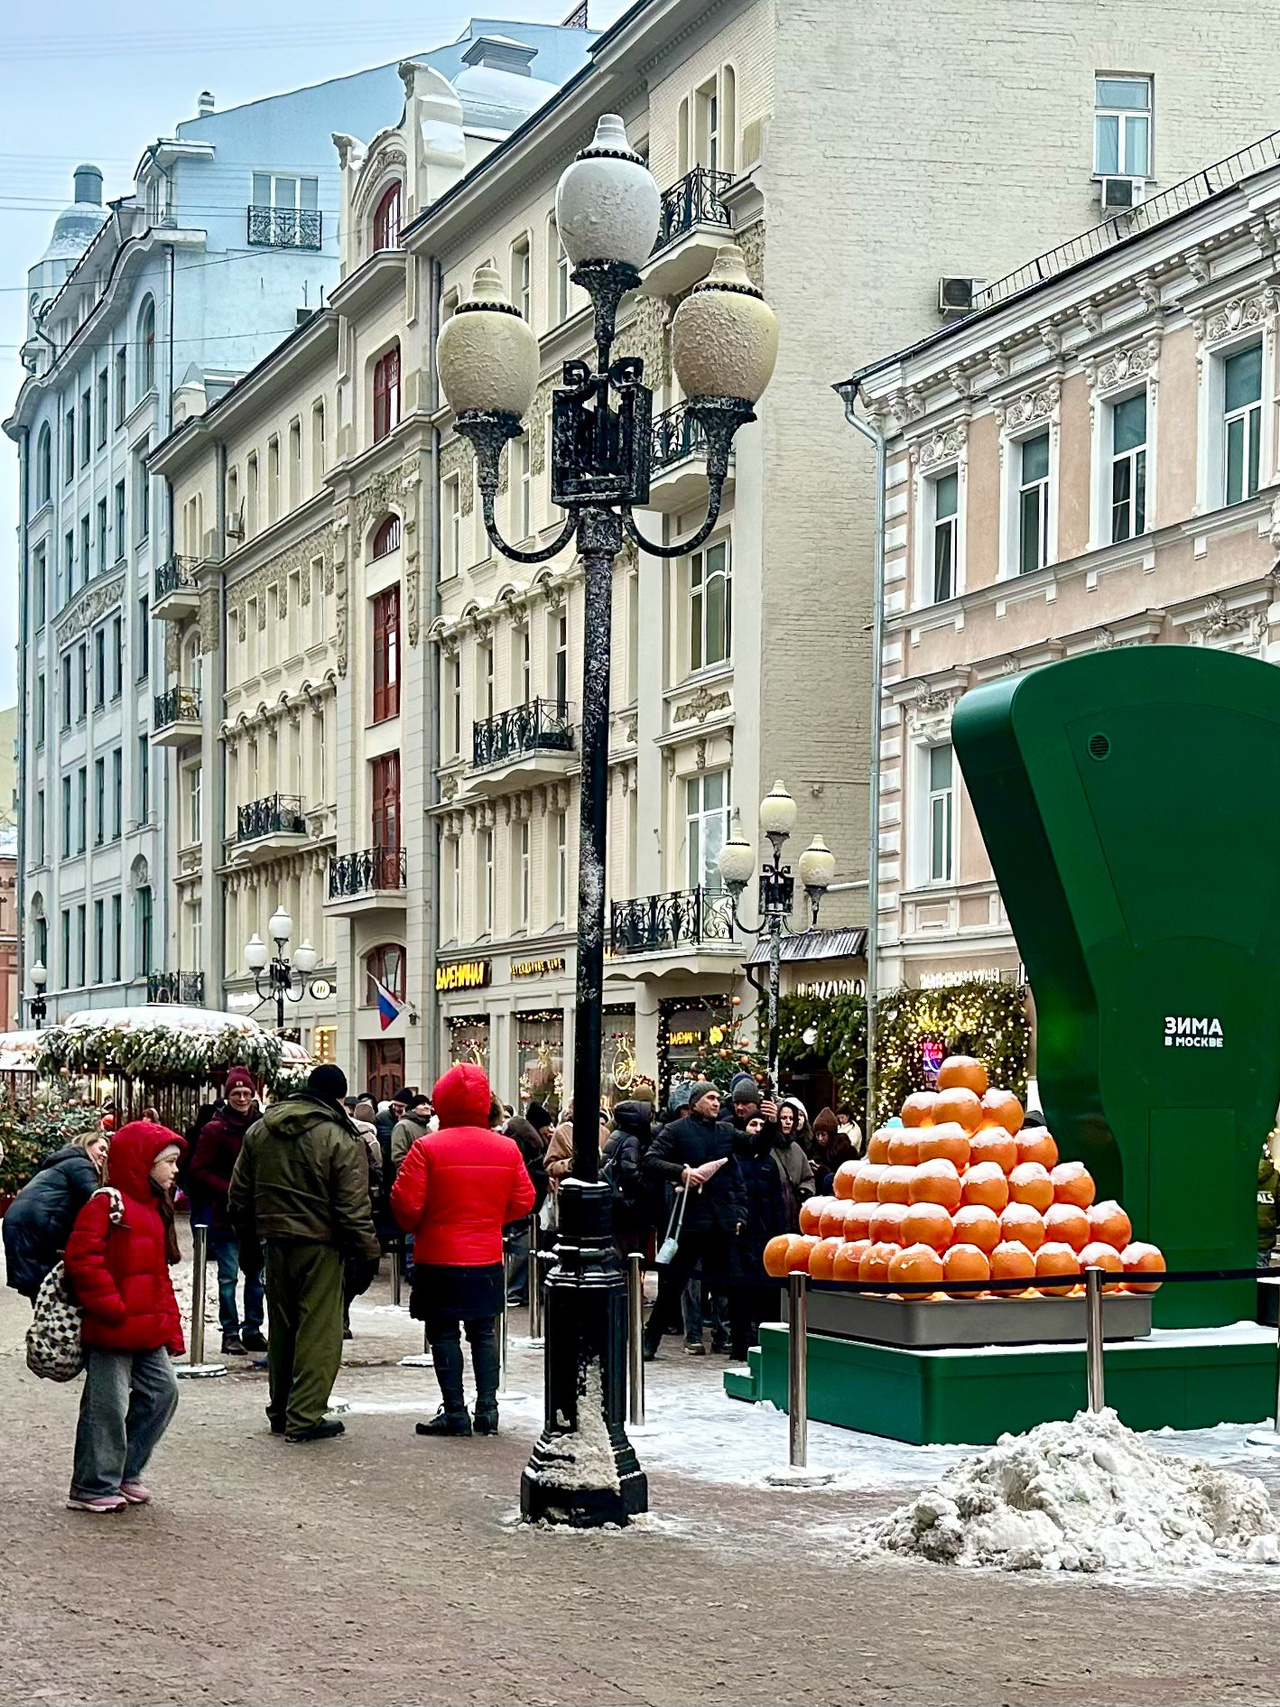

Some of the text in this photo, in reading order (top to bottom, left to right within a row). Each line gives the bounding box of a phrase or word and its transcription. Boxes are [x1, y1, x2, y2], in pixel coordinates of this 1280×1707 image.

[1164, 1016, 1223, 1036] ЗИМА
[1164, 1036, 1224, 1048] В МОСКВЕ
